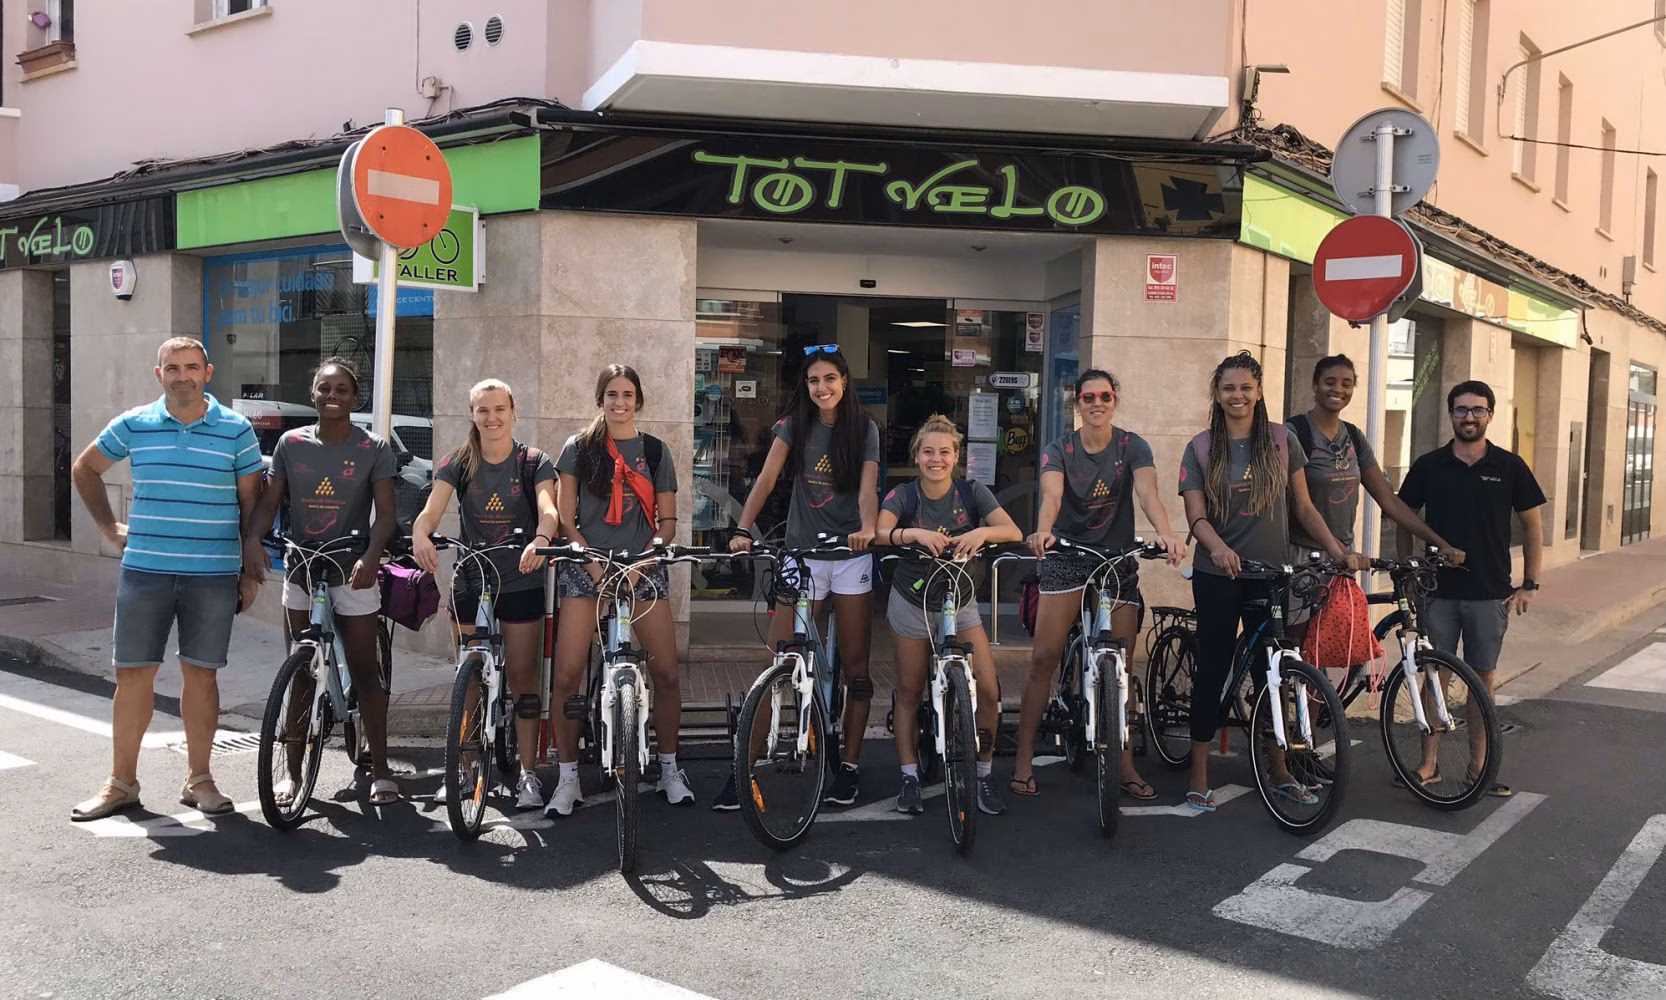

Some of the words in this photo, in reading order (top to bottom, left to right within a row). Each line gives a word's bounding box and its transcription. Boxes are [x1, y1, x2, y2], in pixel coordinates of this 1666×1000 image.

[694, 151, 886, 213] TOT
[887, 159, 1104, 225] VELO
[398, 263, 458, 282] ALLER
[1151, 261, 1172, 270] intec
[1007, 431, 1027, 449] Buff
